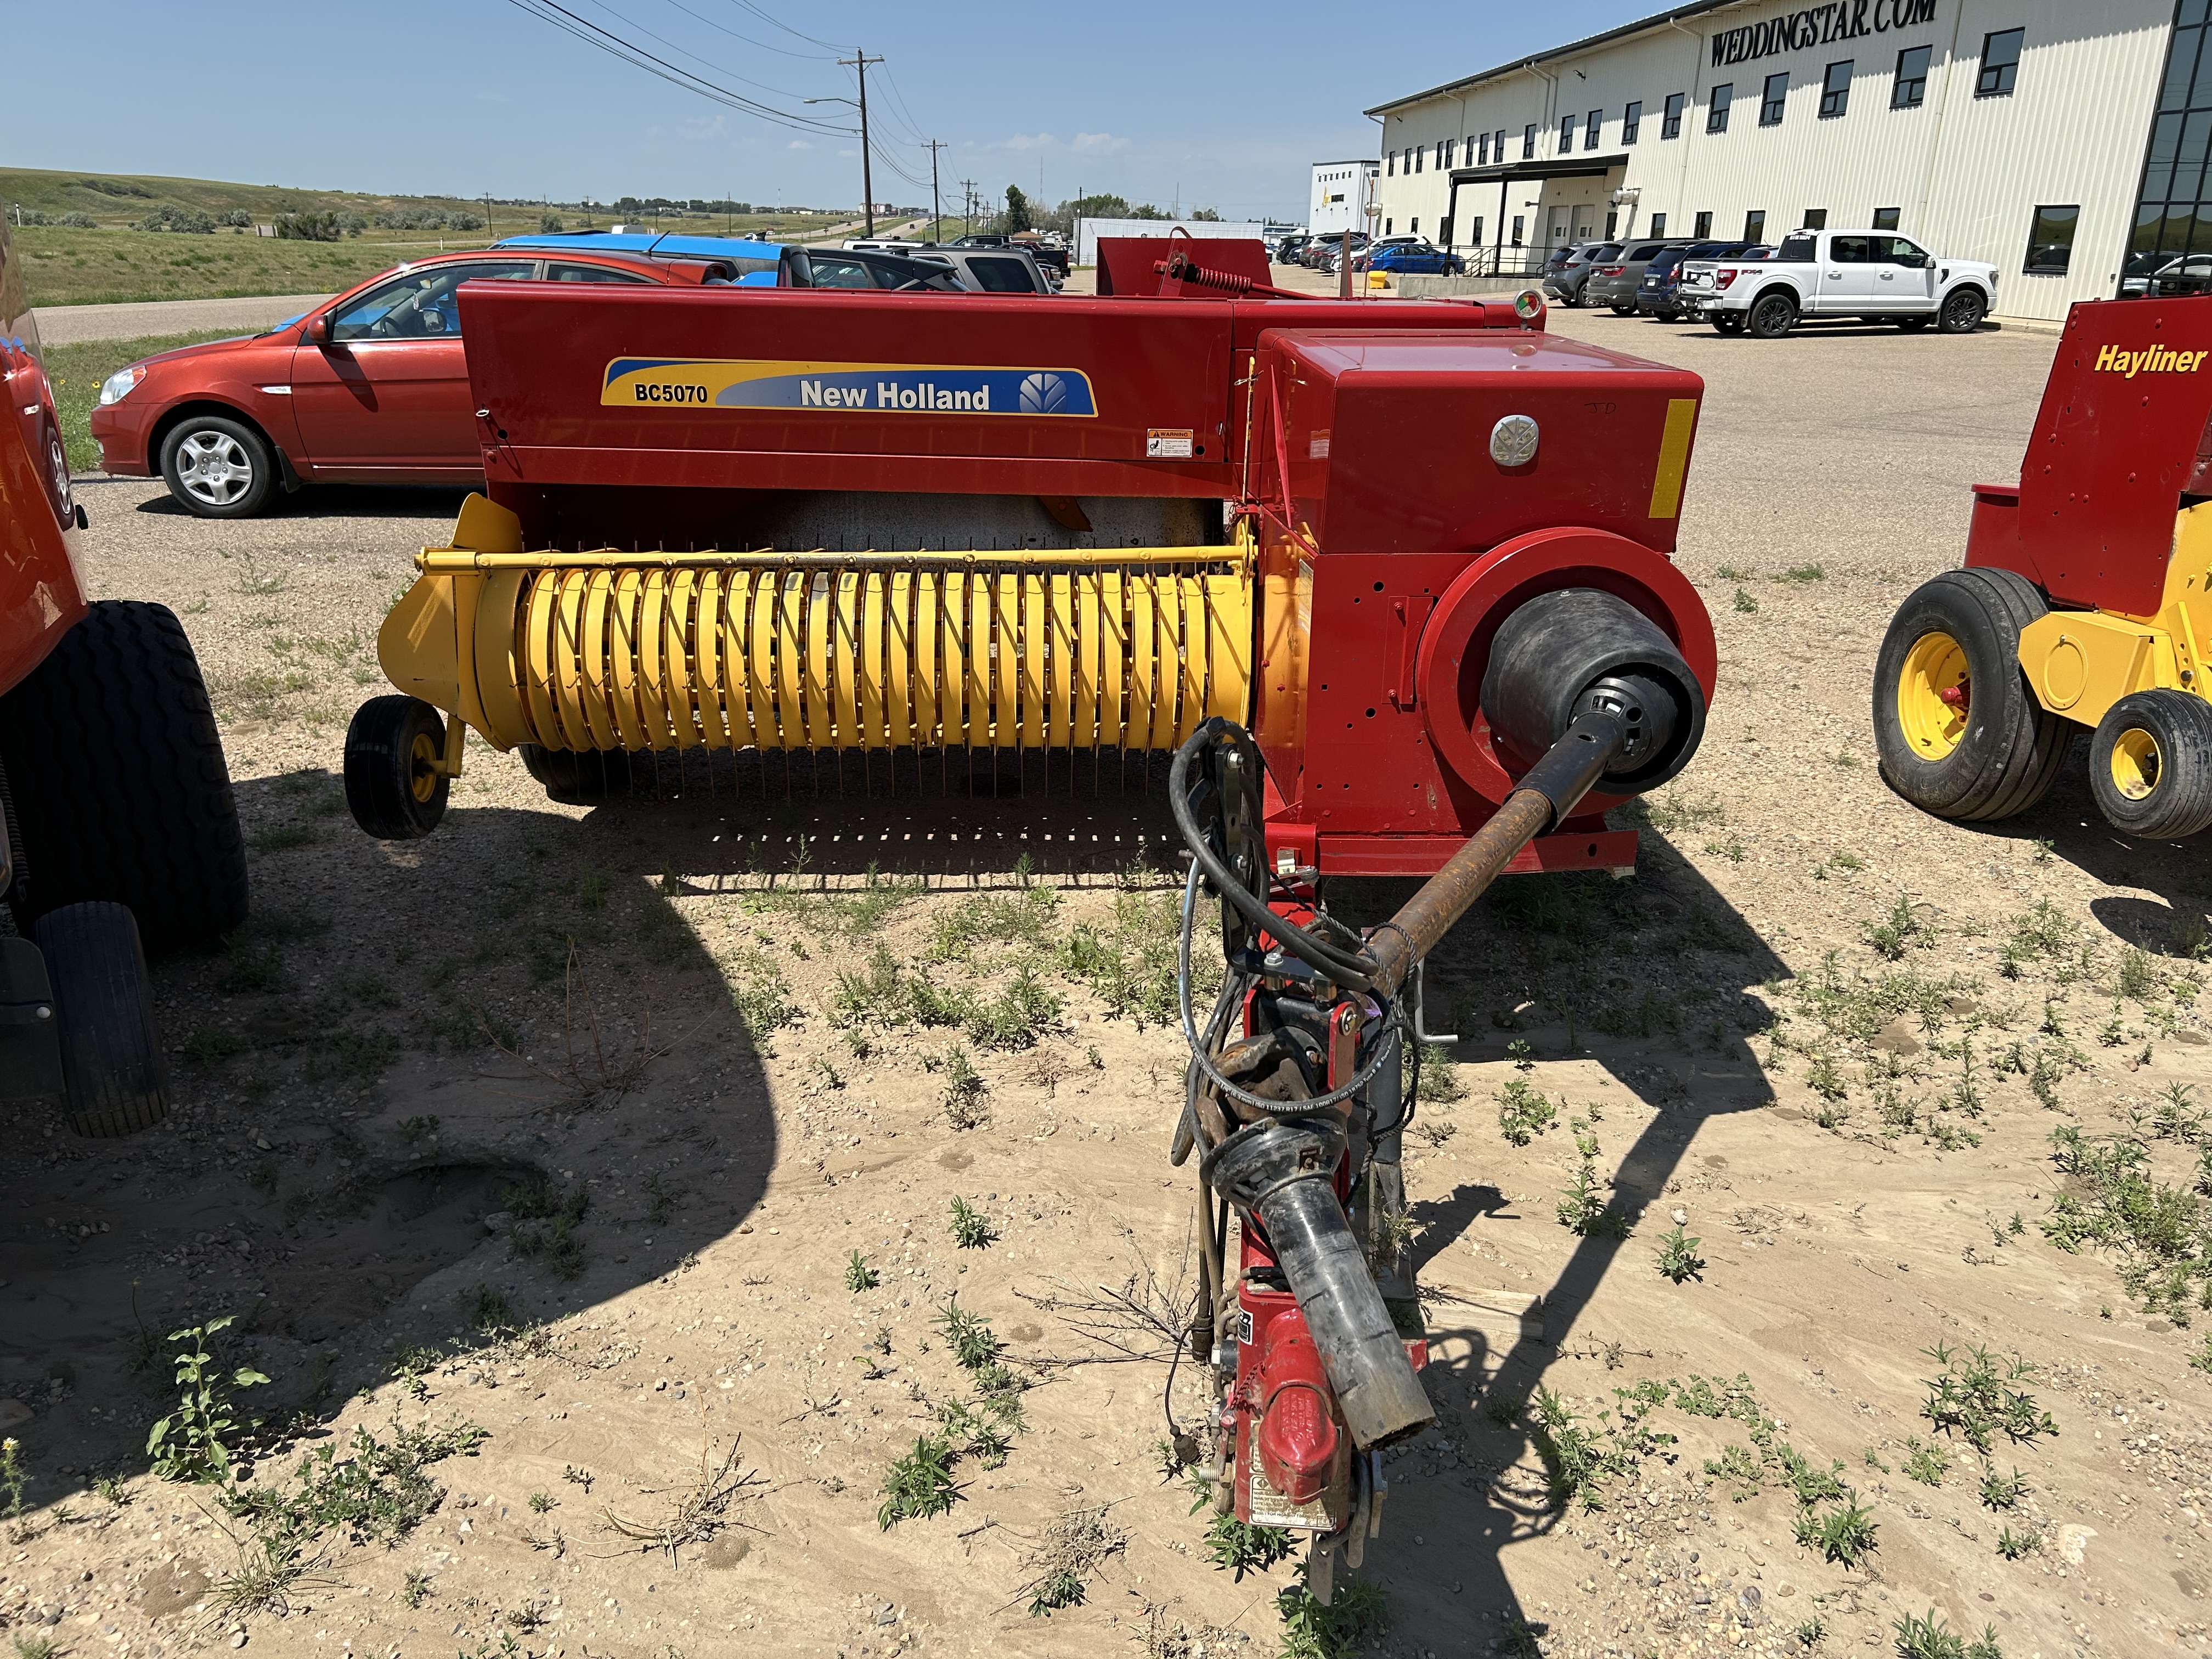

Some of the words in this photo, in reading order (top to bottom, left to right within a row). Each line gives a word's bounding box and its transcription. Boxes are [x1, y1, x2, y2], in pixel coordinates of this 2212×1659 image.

[1712, 0, 1937, 67] WEDDINGSTAR.COM
[2094, 344, 2209, 379] Hayliner
[634, 383, 708, 404] BC5070
[800, 380, 867, 408] New
[876, 382, 990, 411] Holland
